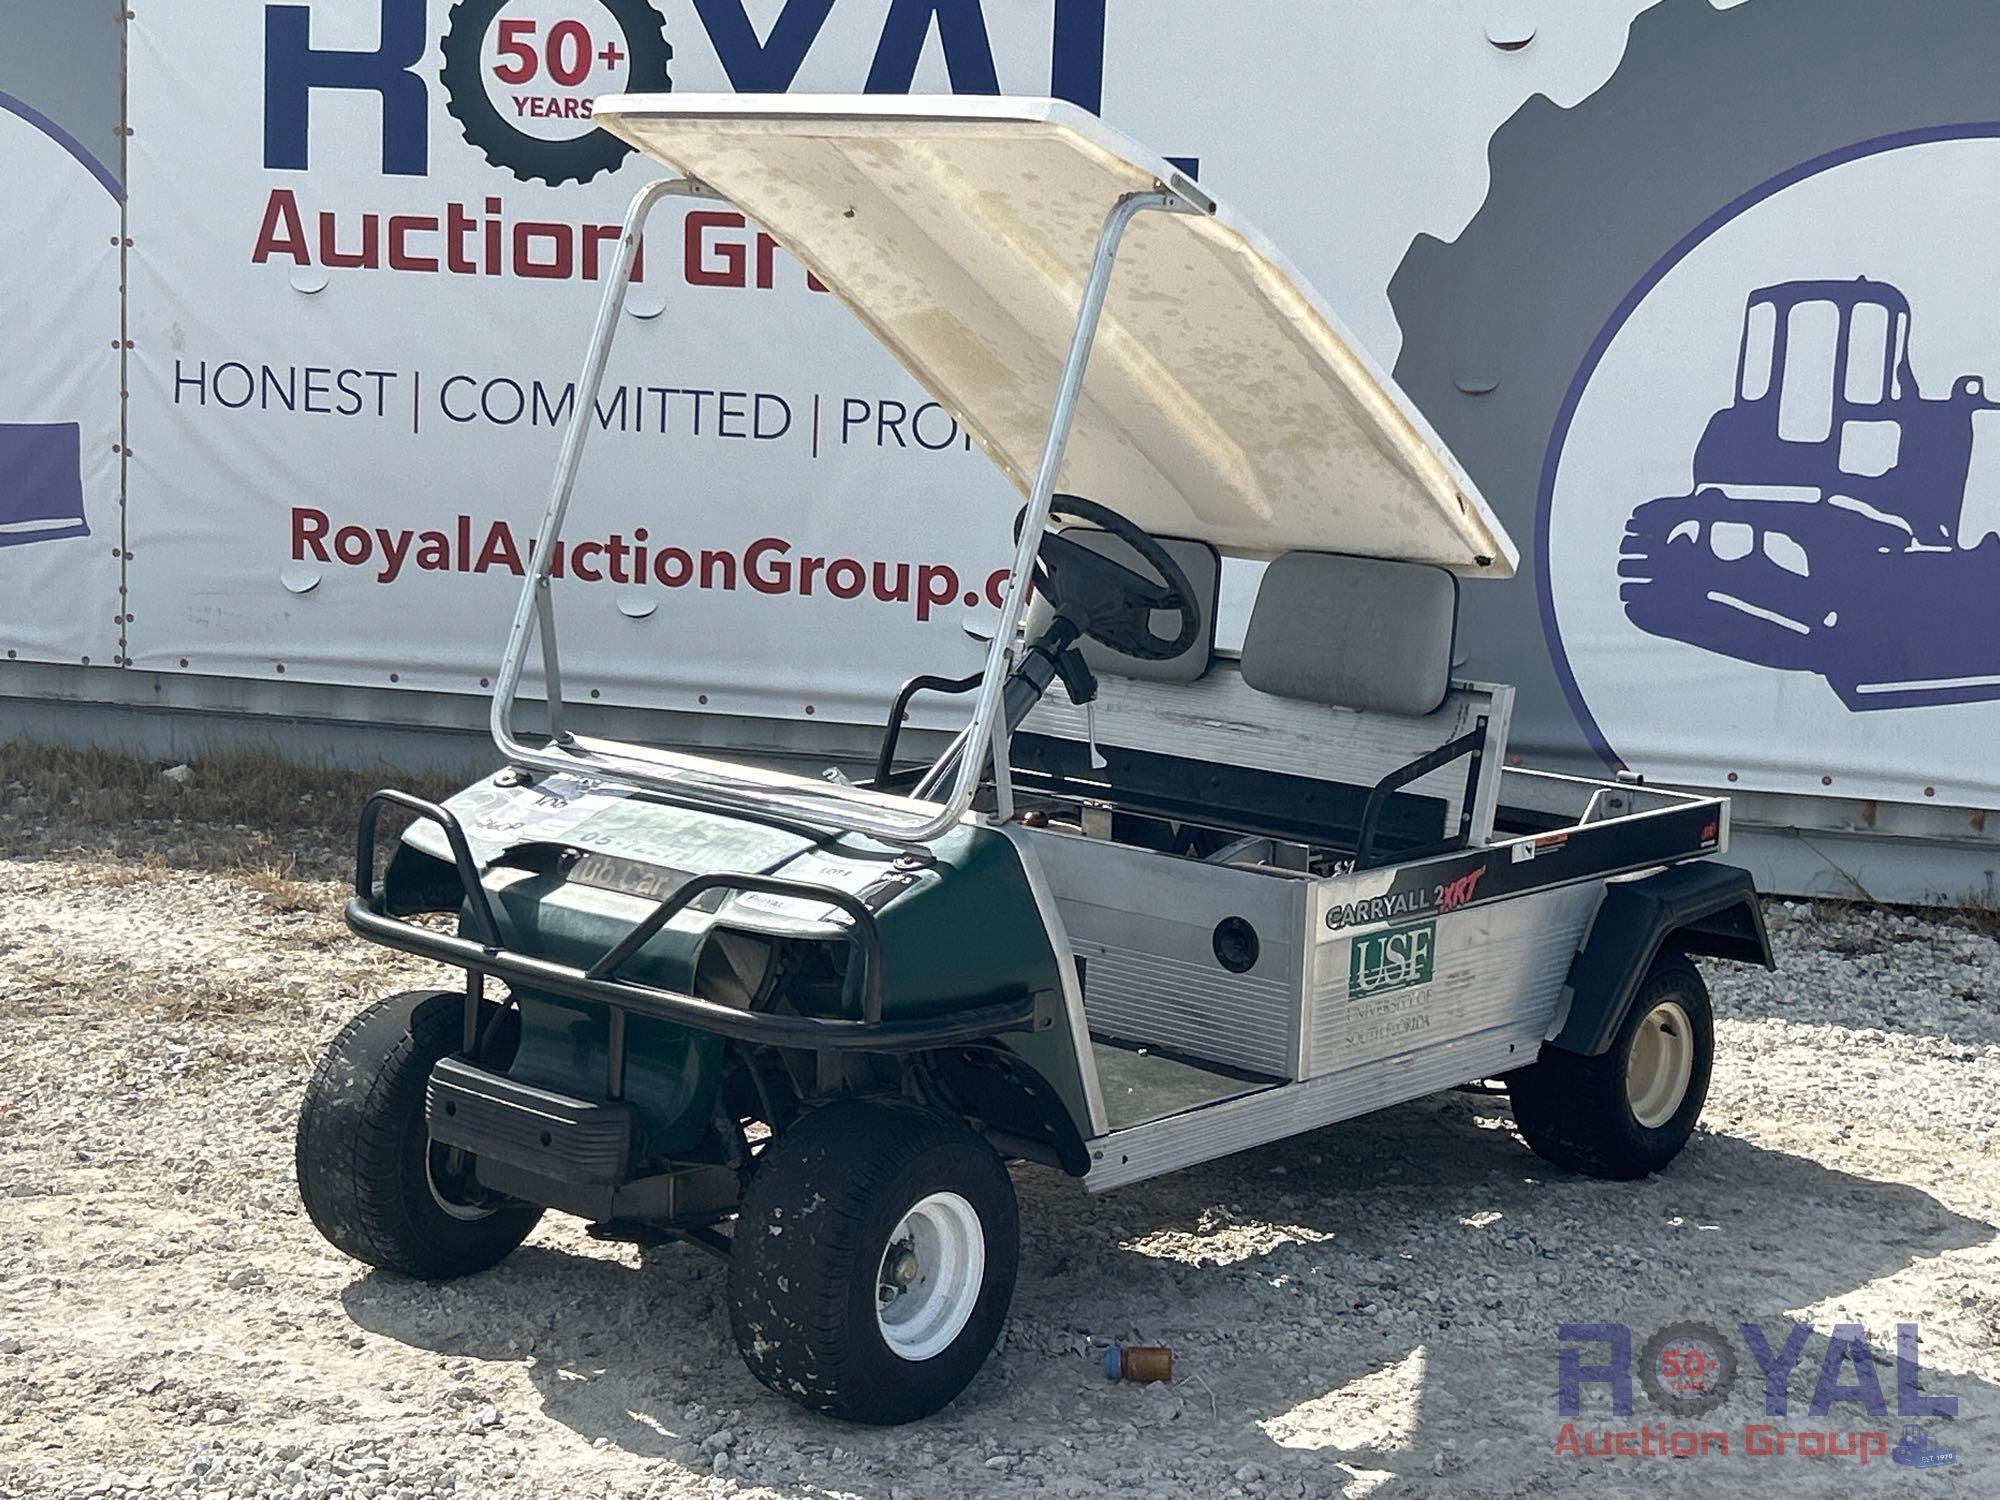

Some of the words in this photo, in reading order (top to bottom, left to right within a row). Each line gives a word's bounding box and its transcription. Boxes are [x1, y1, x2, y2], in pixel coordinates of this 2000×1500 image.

[493, 19, 625, 87] 50+
[512, 96, 594, 119] YEARS
[252, 189, 643, 283] Auction
[174, 360, 397, 418] HONEST
[440, 375, 792, 441] COMMITTED
[619, 863, 671, 897] Car
[1326, 886, 1430, 929] CARRYALL
[1357, 927, 1432, 991] USF
